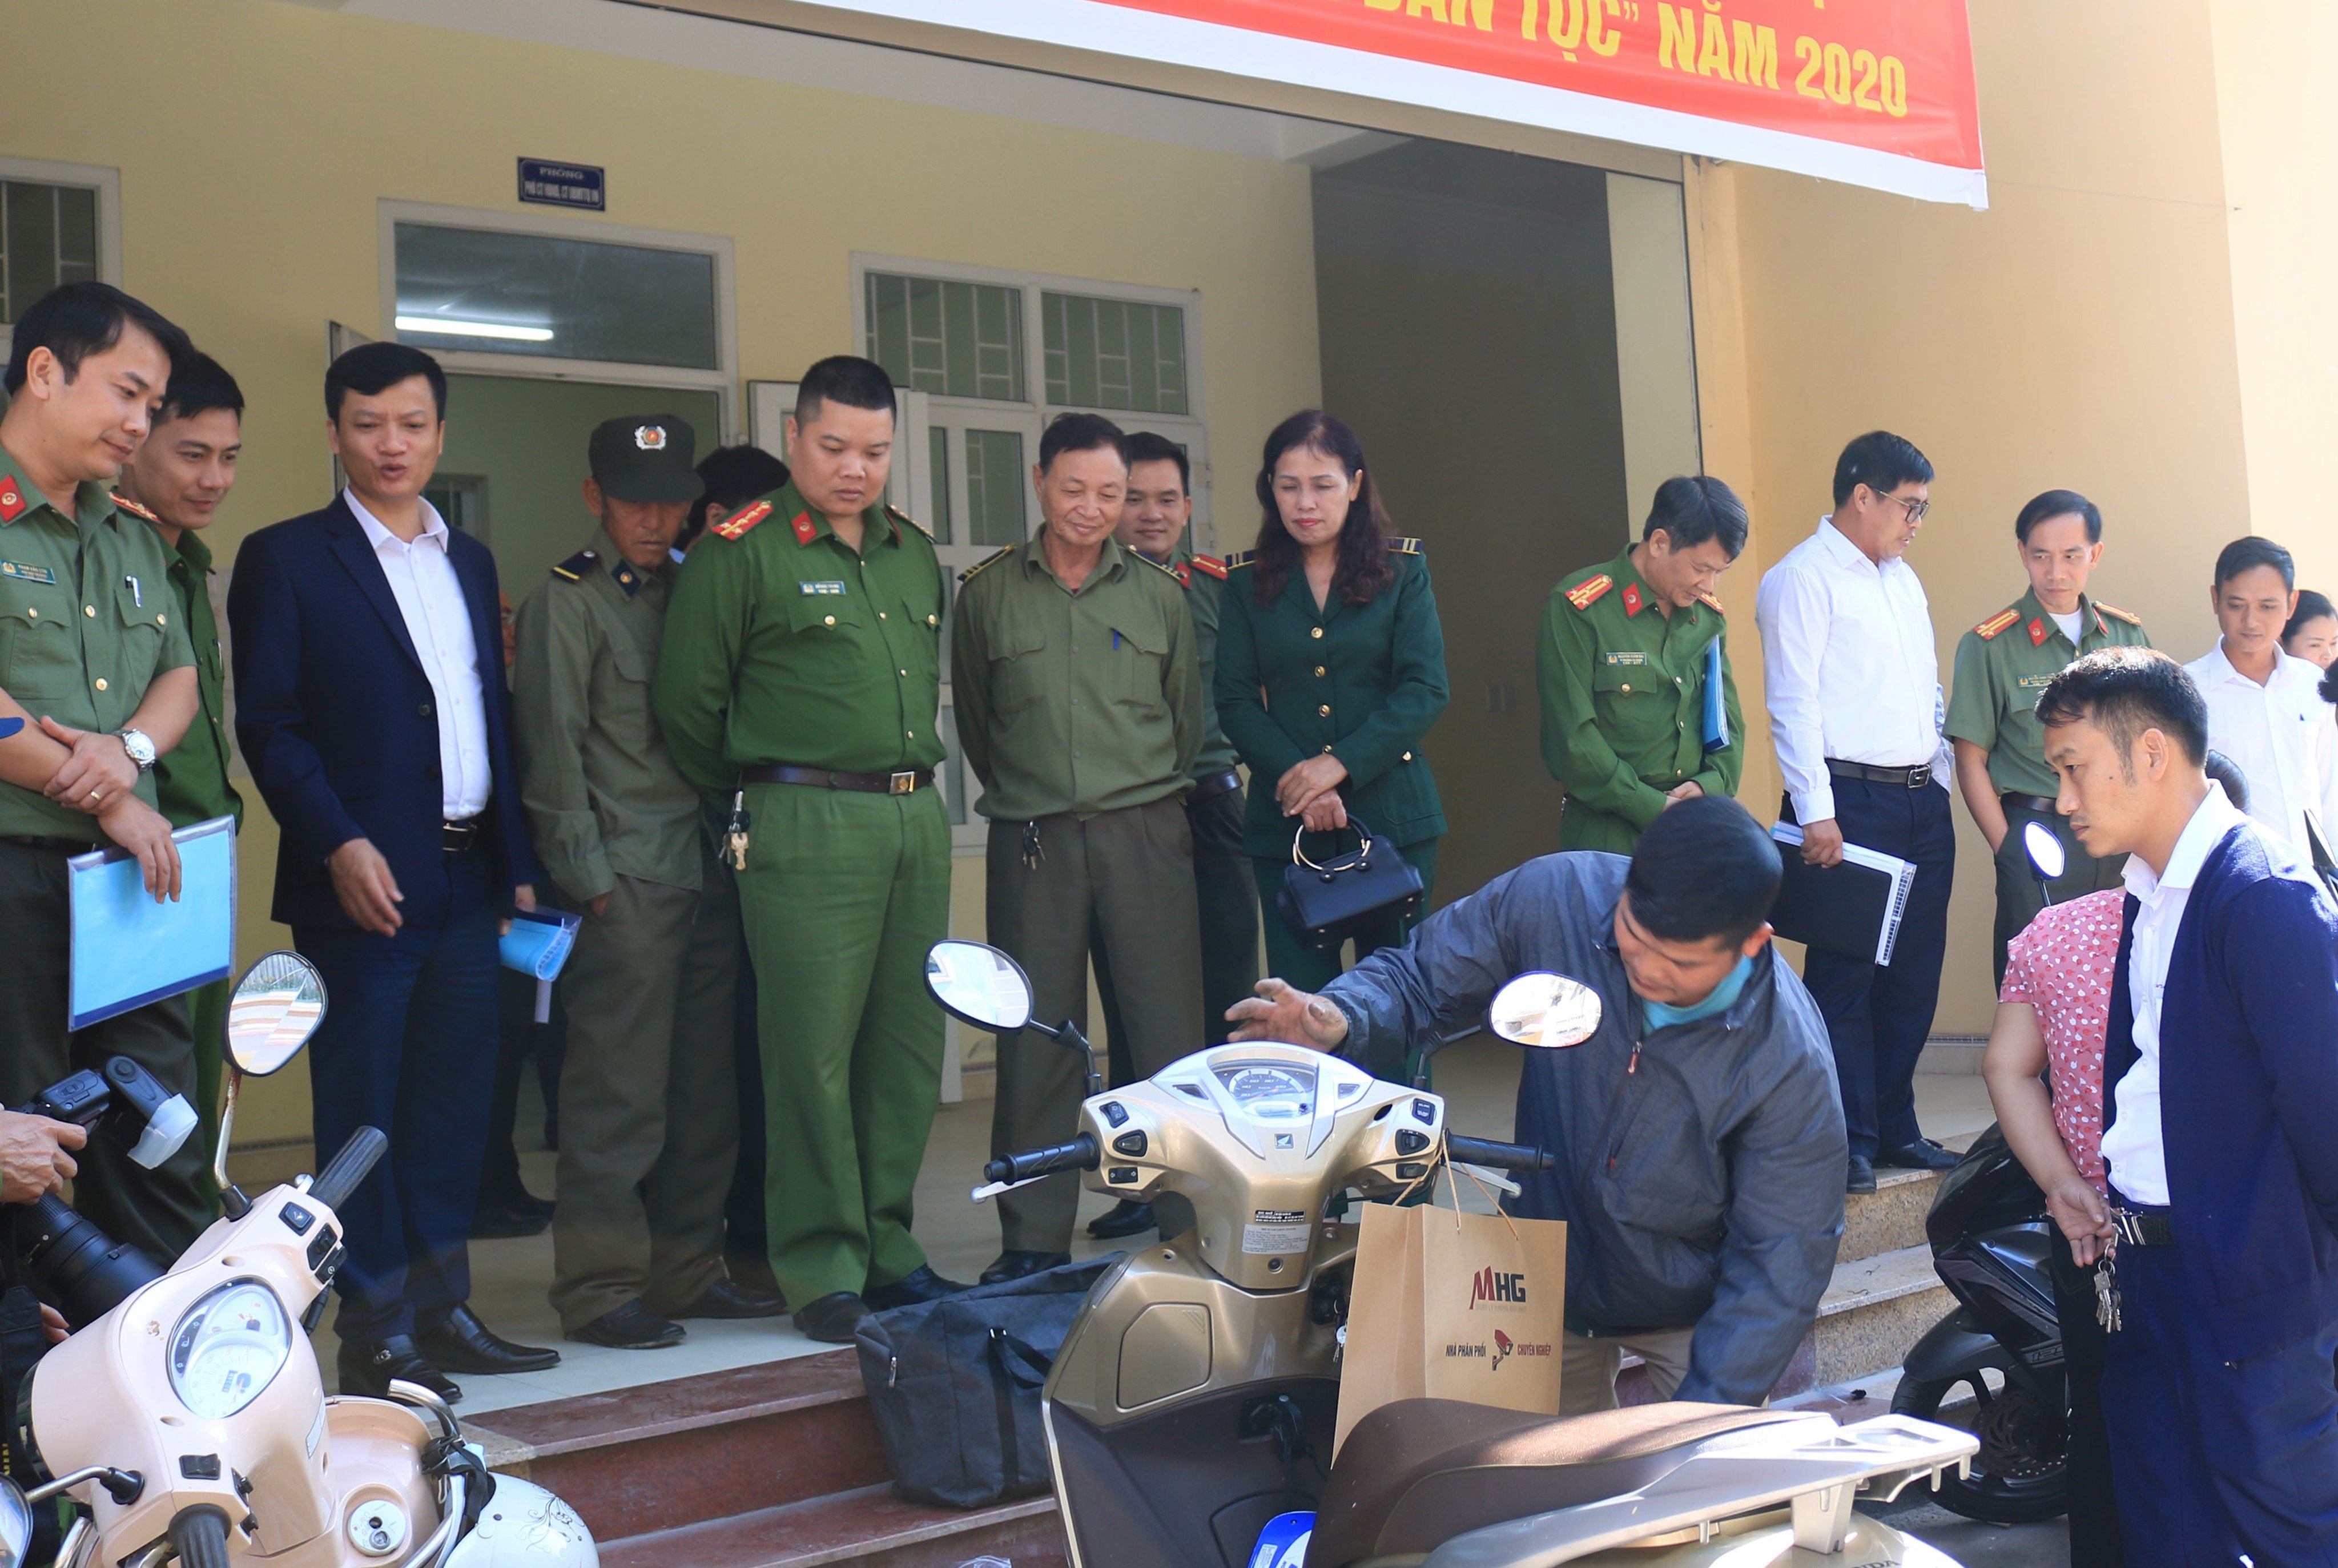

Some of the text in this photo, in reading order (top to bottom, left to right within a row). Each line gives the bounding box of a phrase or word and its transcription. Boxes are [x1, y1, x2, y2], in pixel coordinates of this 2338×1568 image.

[1659, 0, 1780, 90] NĂM
[1795, 35, 1908, 118] 2020
[1468, 1265, 1527, 1310] MHG
[1446, 1341, 1551, 1359] NHÀ PHÂN PHỐI CHUYÊN NGHIỆP
